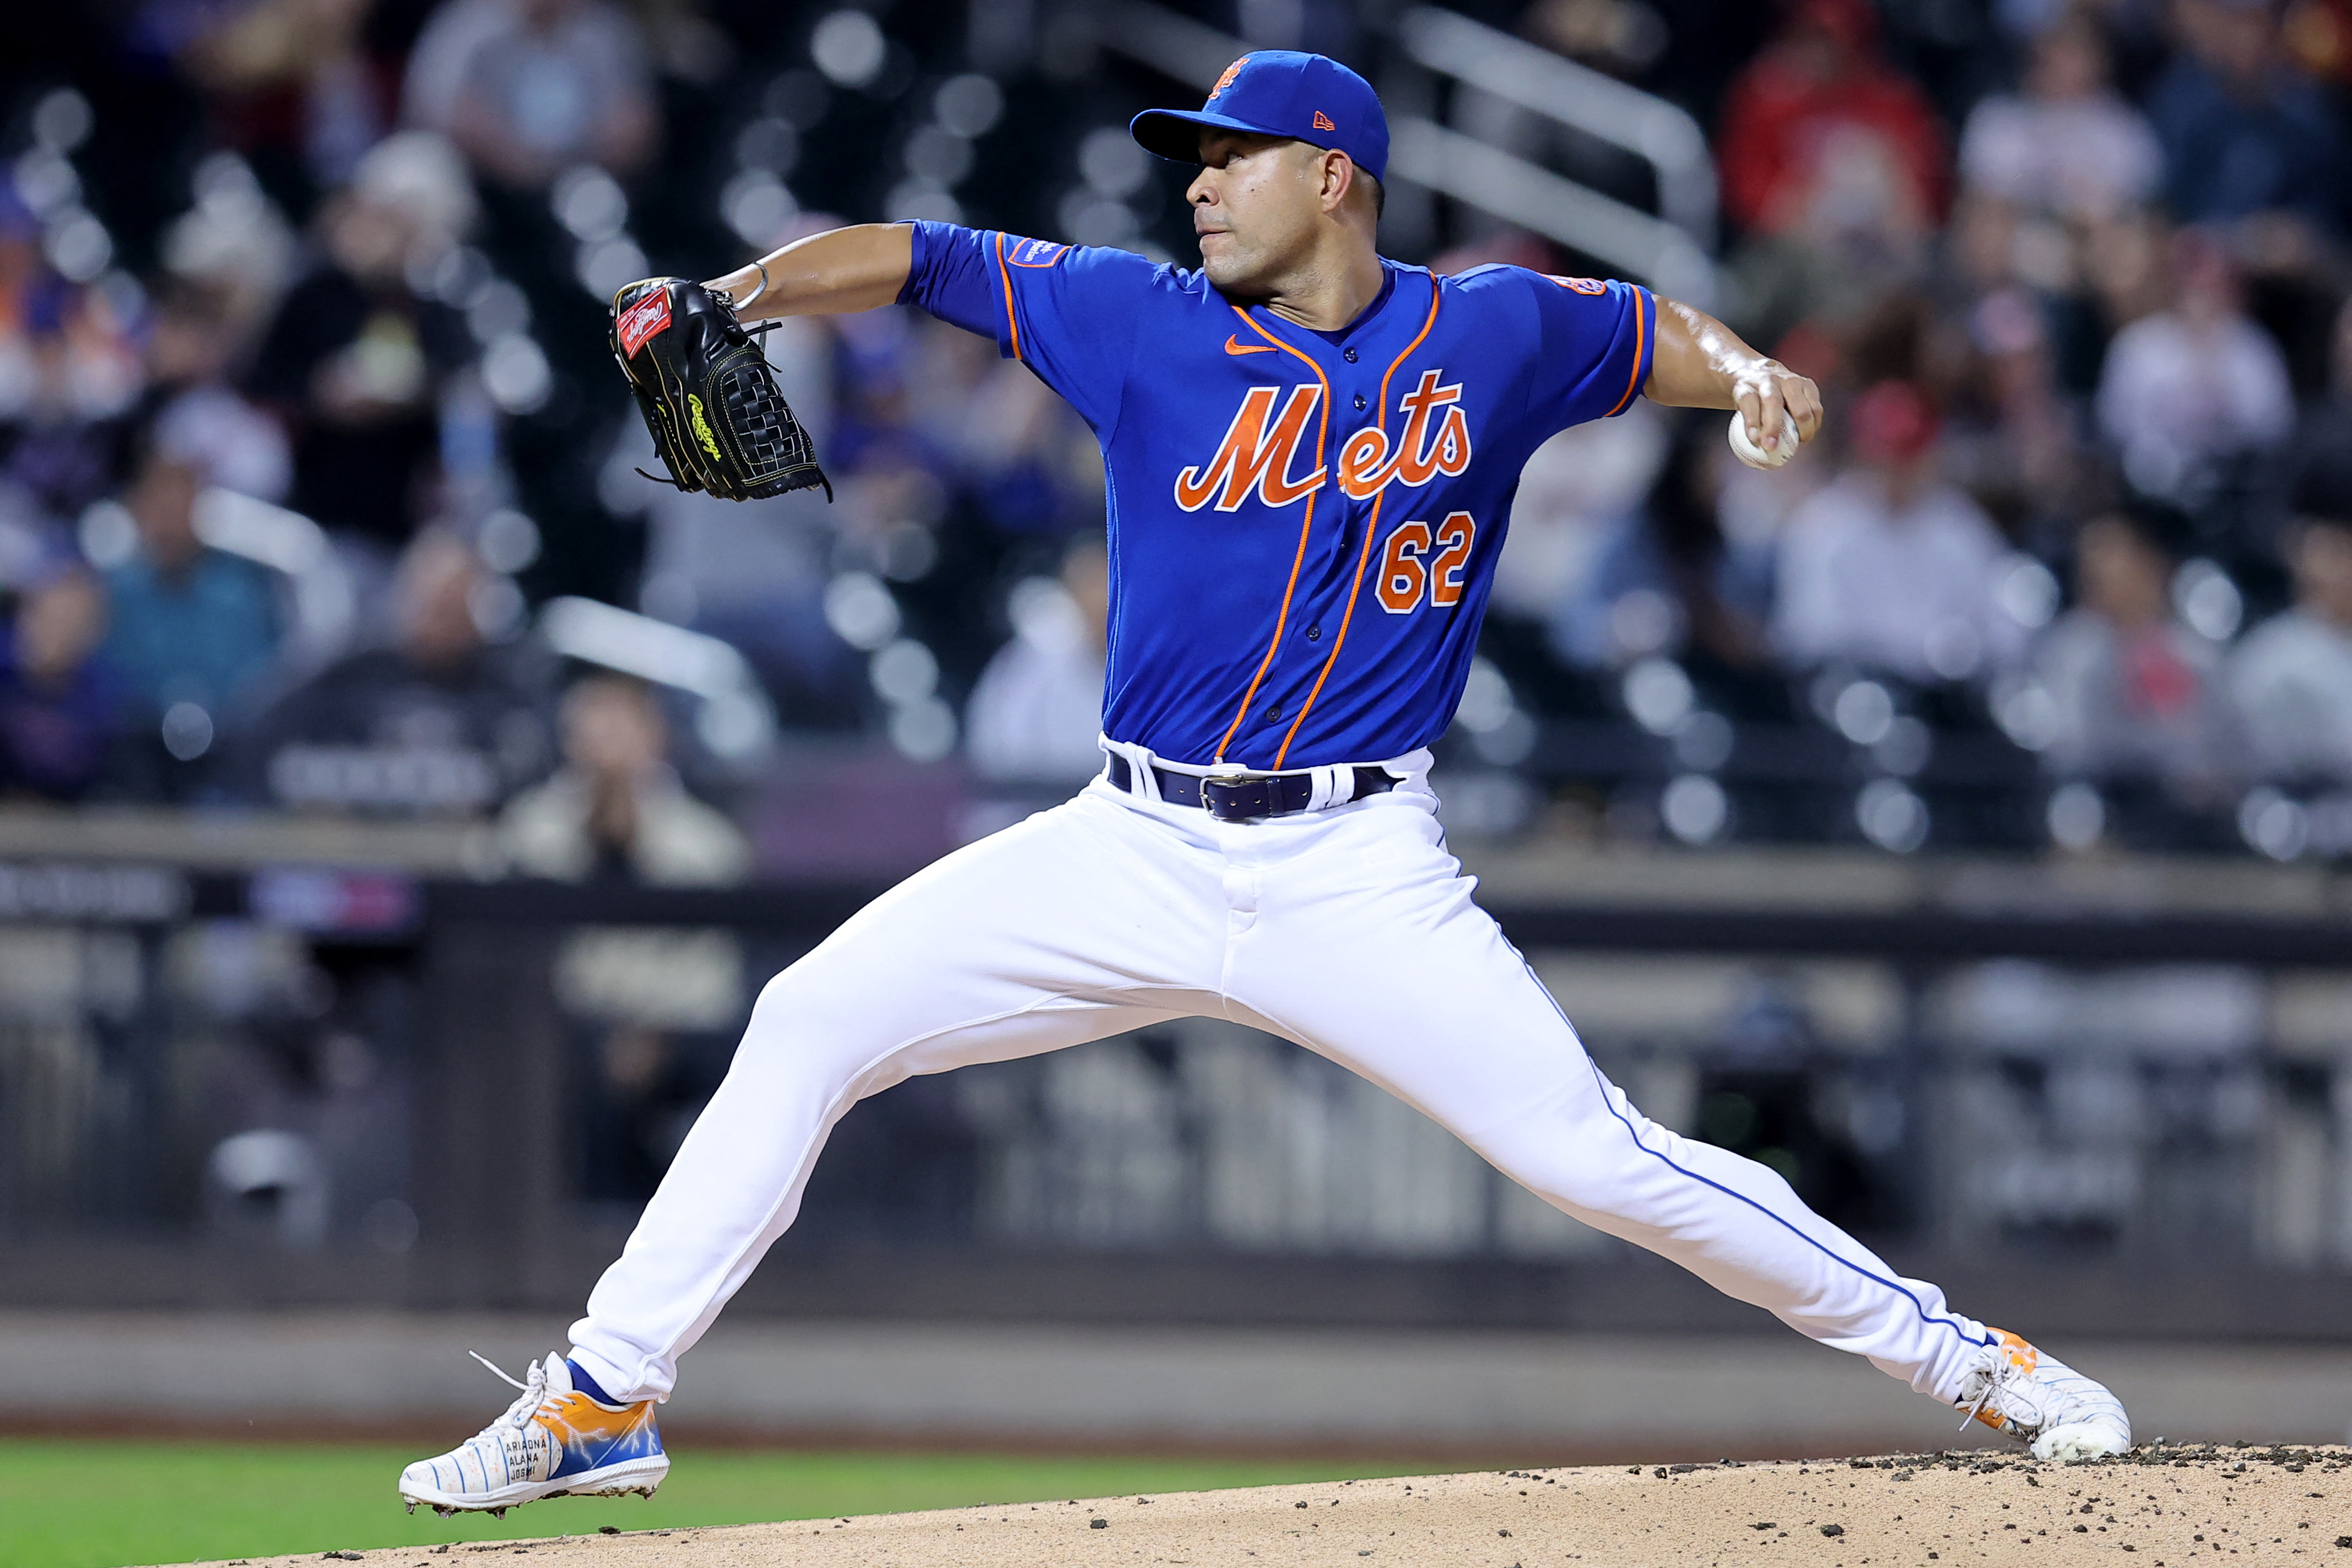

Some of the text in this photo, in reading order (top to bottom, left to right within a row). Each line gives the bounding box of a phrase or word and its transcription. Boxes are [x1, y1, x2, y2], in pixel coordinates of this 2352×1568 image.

[626, 301, 663, 343] Rawlings
[688, 393, 722, 462] Rawlings
[1174, 368, 1472, 513] Mets
[1375, 511, 1476, 614] 62
[506, 1438, 547, 1453] ARIADNA
[510, 1452, 539, 1467] ALANA
